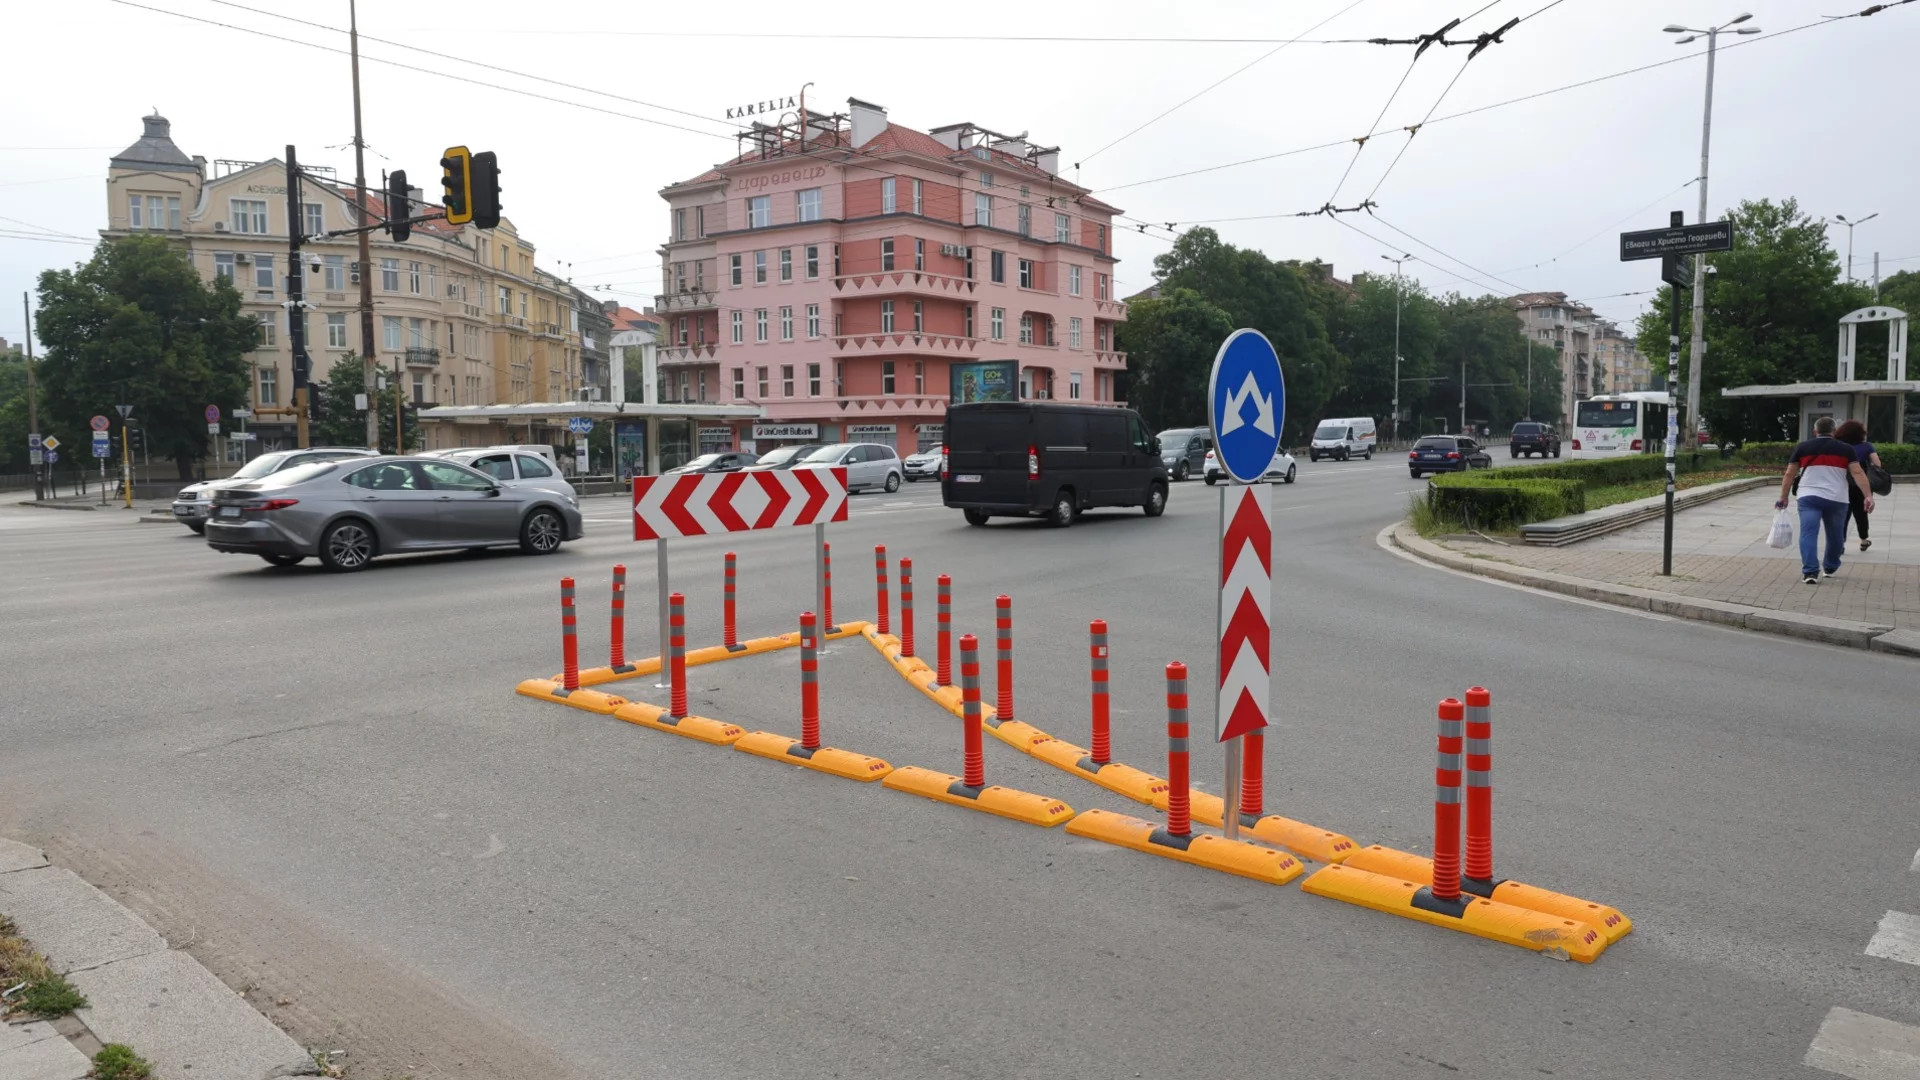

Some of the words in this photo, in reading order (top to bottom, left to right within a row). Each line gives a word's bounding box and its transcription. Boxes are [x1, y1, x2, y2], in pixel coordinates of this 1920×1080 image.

[726, 96, 796, 119] KARELIA
[1625, 240, 1650, 249] Евлоги
[1657, 236, 1686, 246] Христо
[1688, 231, 1727, 242] Георгиеви
[764, 427, 788, 436] UniCredit
[790, 427, 813, 436] Bulbank
